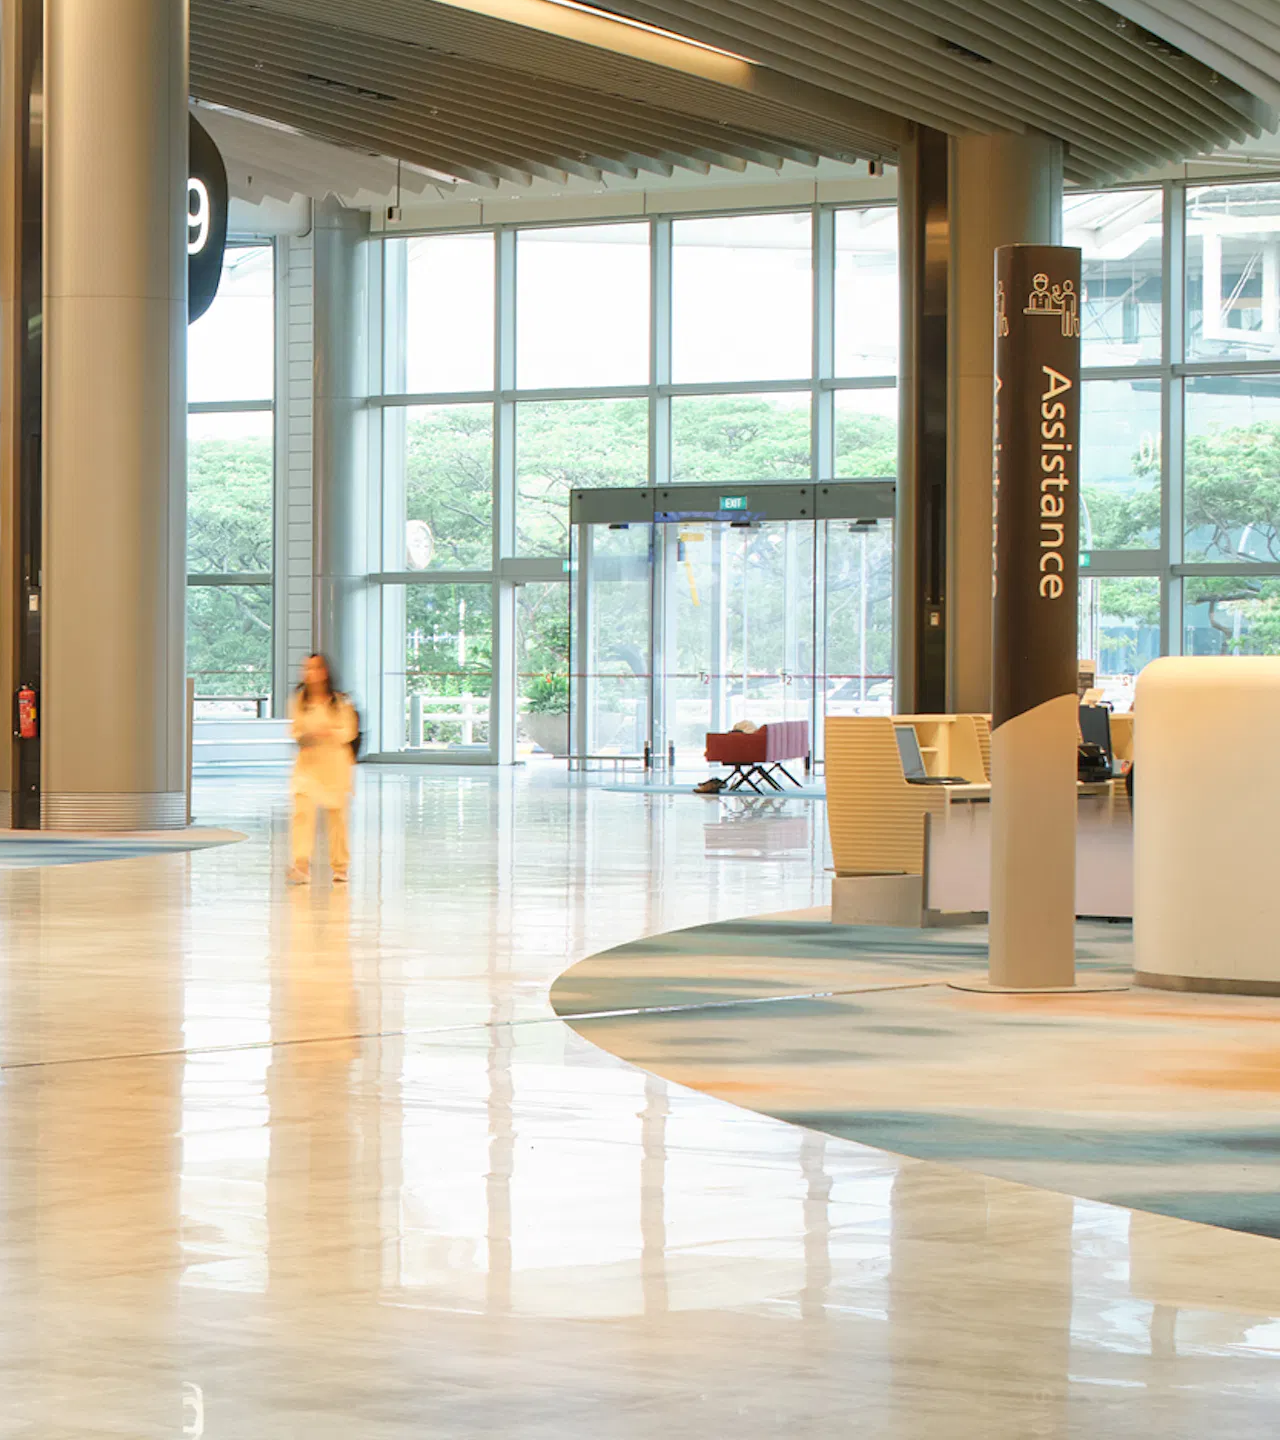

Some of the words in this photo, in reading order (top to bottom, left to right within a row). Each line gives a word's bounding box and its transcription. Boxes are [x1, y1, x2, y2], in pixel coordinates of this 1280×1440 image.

[187, 177, 208, 255] 9
[724, 497, 743, 509] EXIT
[1040, 365, 1073, 600] Assistance
